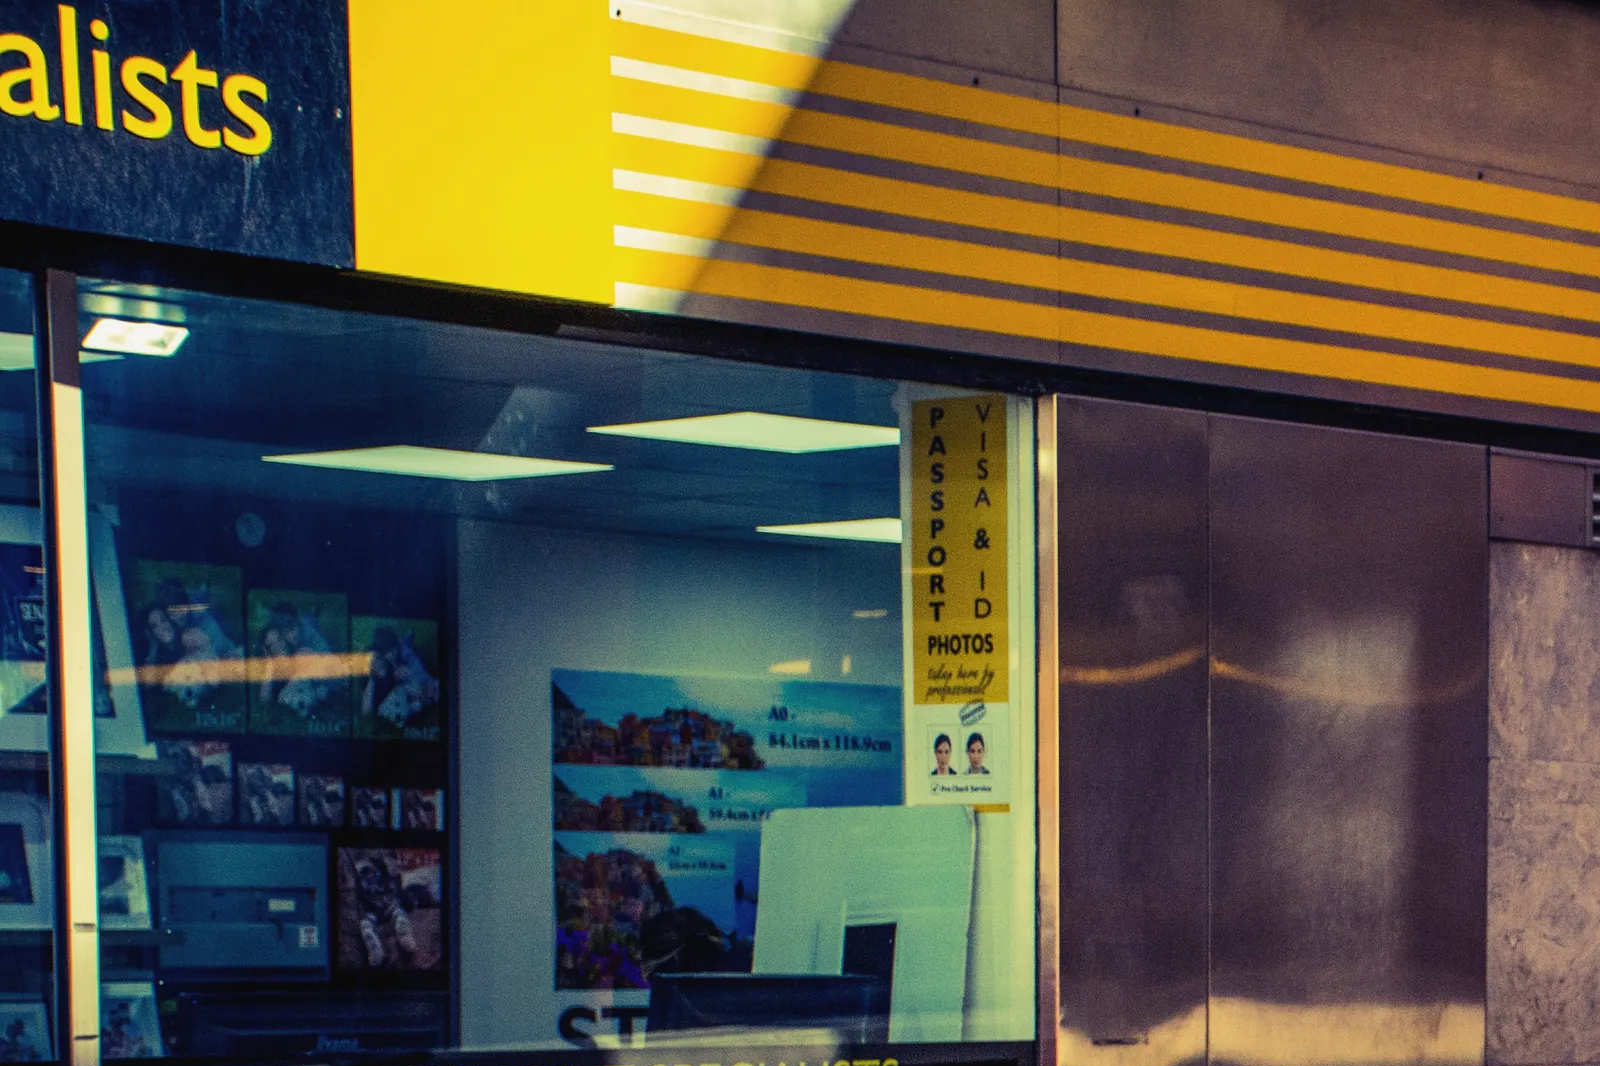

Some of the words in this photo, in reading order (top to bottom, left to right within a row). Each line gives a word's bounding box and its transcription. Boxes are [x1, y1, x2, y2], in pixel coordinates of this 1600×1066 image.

[0, 4, 272, 156] alists
[974, 404, 991, 508] VISA
[928, 406, 947, 622] PASSPORT
[973, 528, 990, 550] &
[974, 570, 992, 619] ID
[928, 633, 994, 656] PHOTOS
